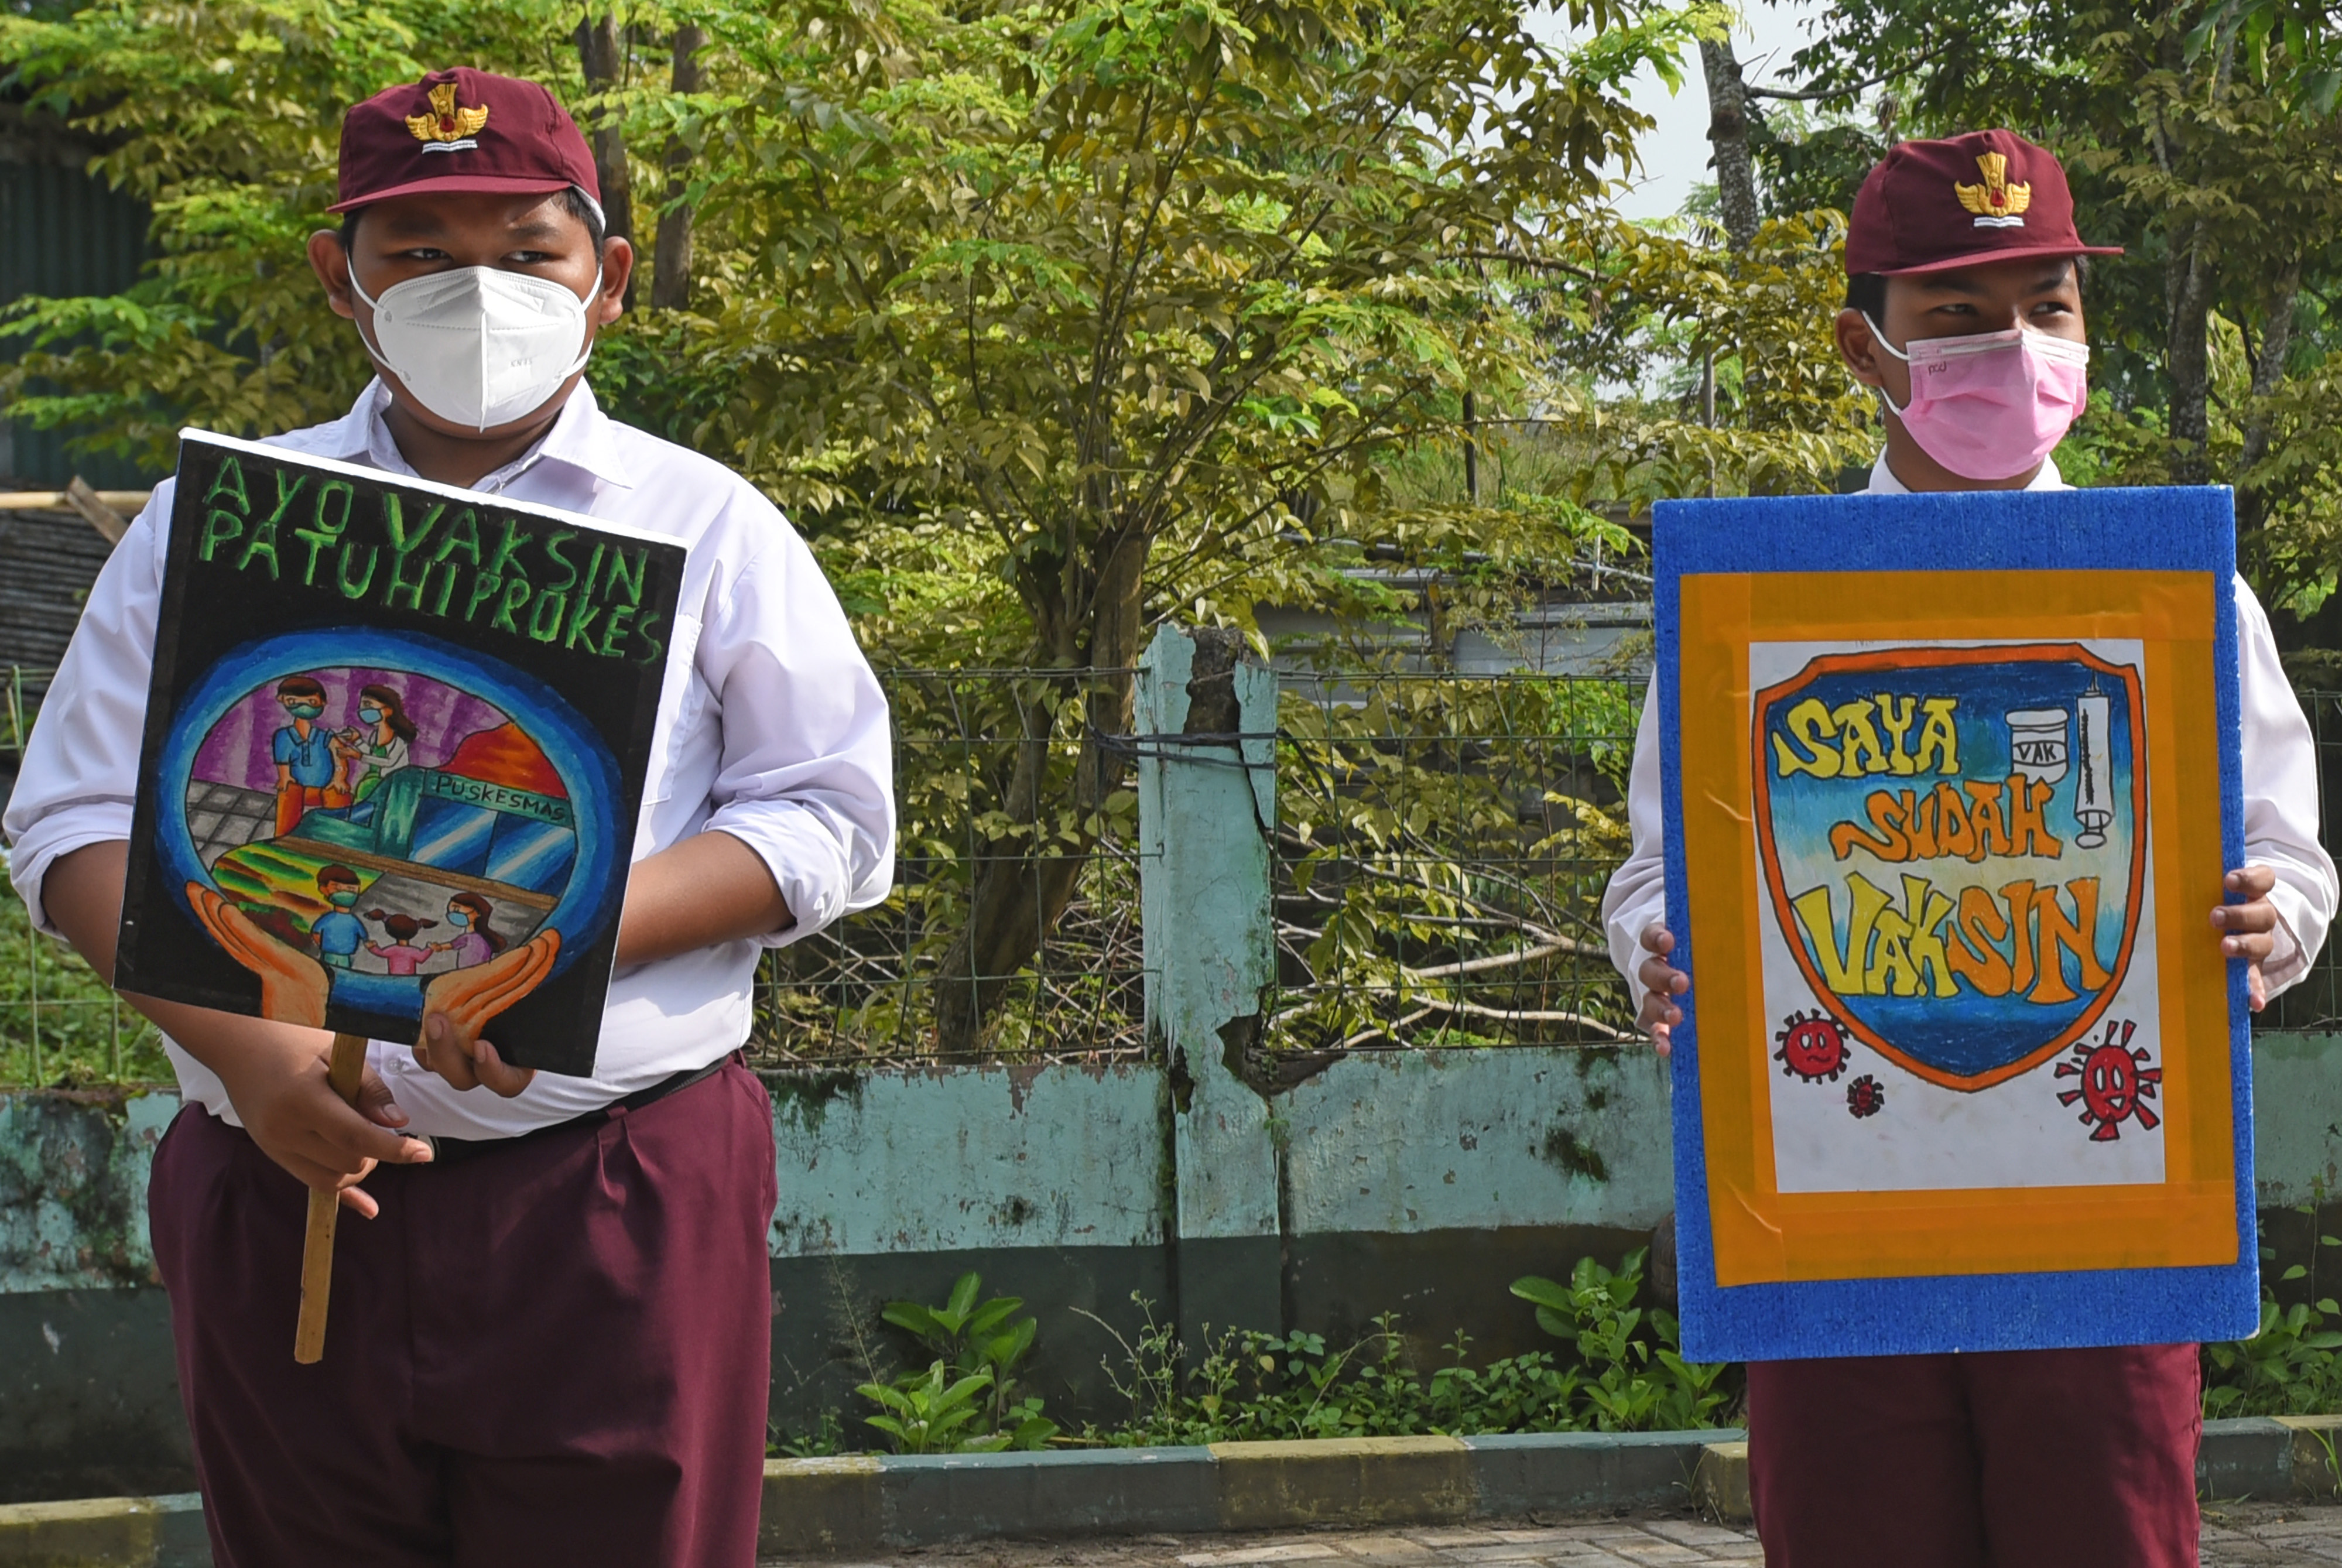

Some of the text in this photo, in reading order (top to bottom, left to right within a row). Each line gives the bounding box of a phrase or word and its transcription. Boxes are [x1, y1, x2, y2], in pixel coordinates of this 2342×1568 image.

[203, 455, 648, 607] AYO VAKSIN
[198, 509, 662, 665] PATUHI PROKES
[1771, 692, 1961, 778] SAYA
[2017, 742, 2056, 763] VAK
[435, 775, 566, 820] PUSKESMAS
[1828, 772, 2062, 864] SUDAH
[1790, 871, 2112, 1004] VAKSIN
